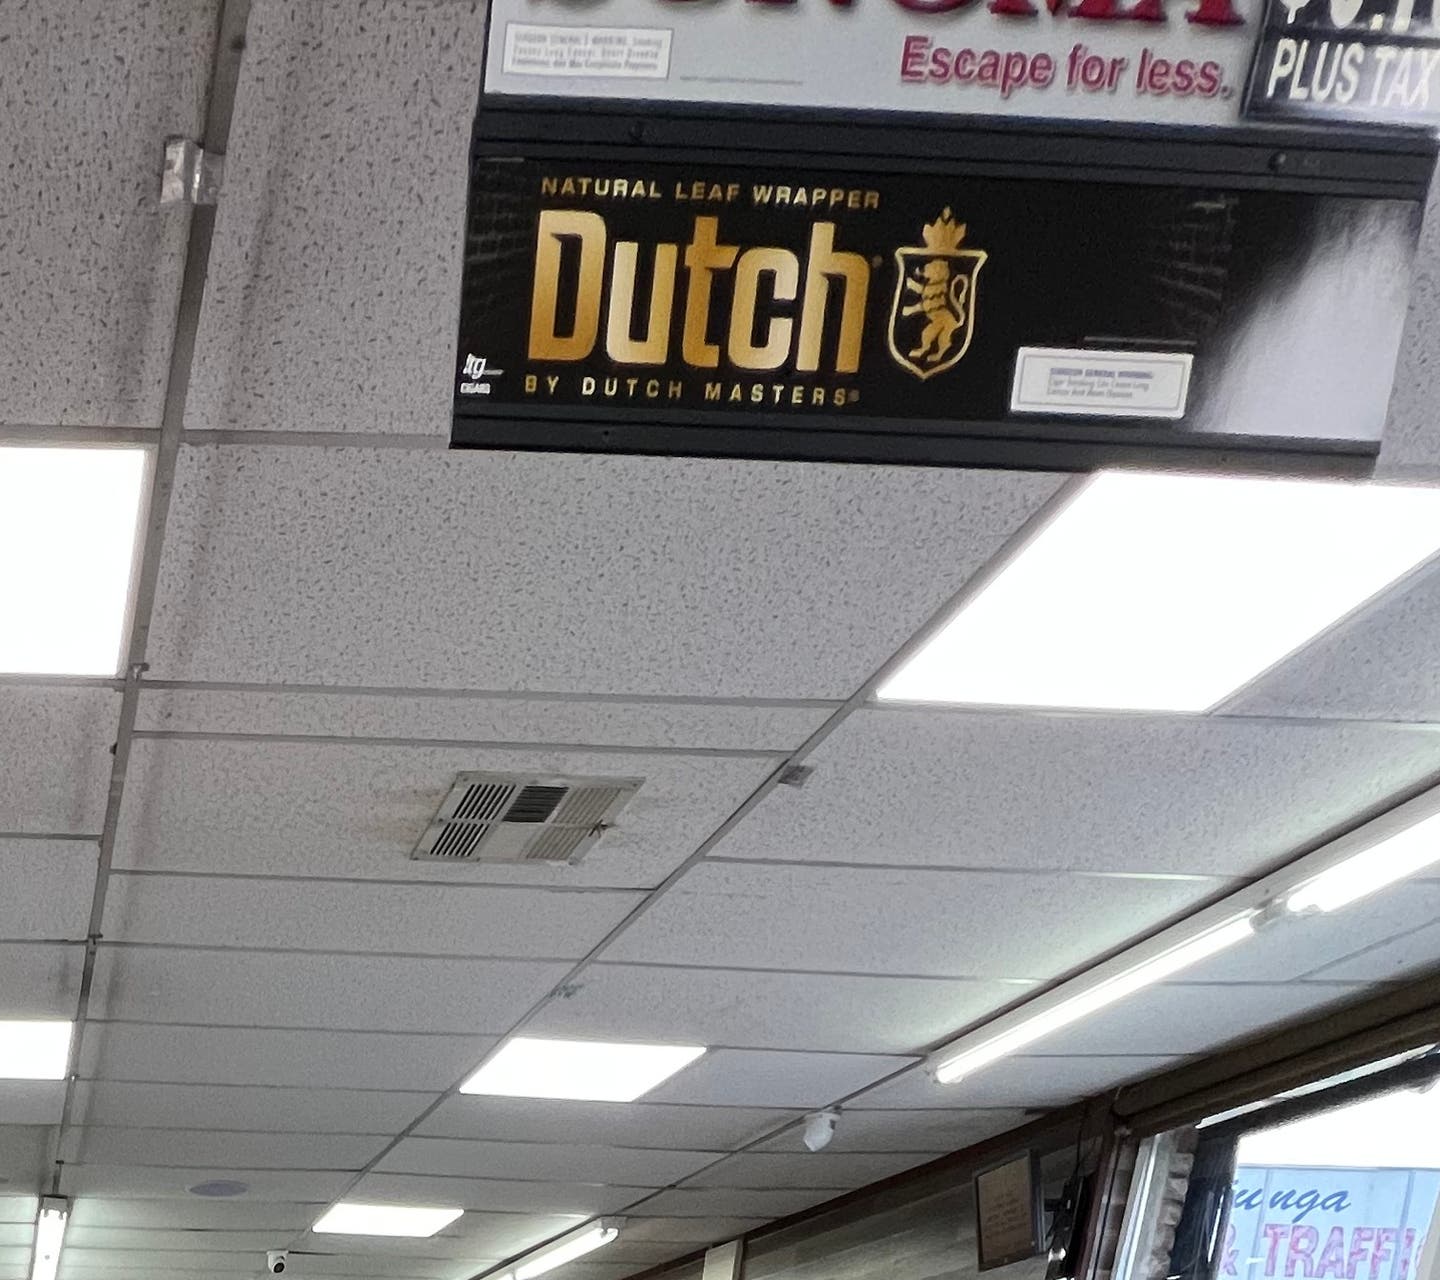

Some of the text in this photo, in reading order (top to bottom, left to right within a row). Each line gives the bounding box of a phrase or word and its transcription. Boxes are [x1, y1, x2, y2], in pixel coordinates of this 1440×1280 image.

[900, 34, 1233, 98] Escape for less.
[1266, 37, 1440, 106] PLUS TAX
[540, 176, 881, 210] NATURAL LEAF WRAPPER
[526, 208, 872, 375] Dutch
[524, 376, 850, 408] BY DUTCH MASTERS
